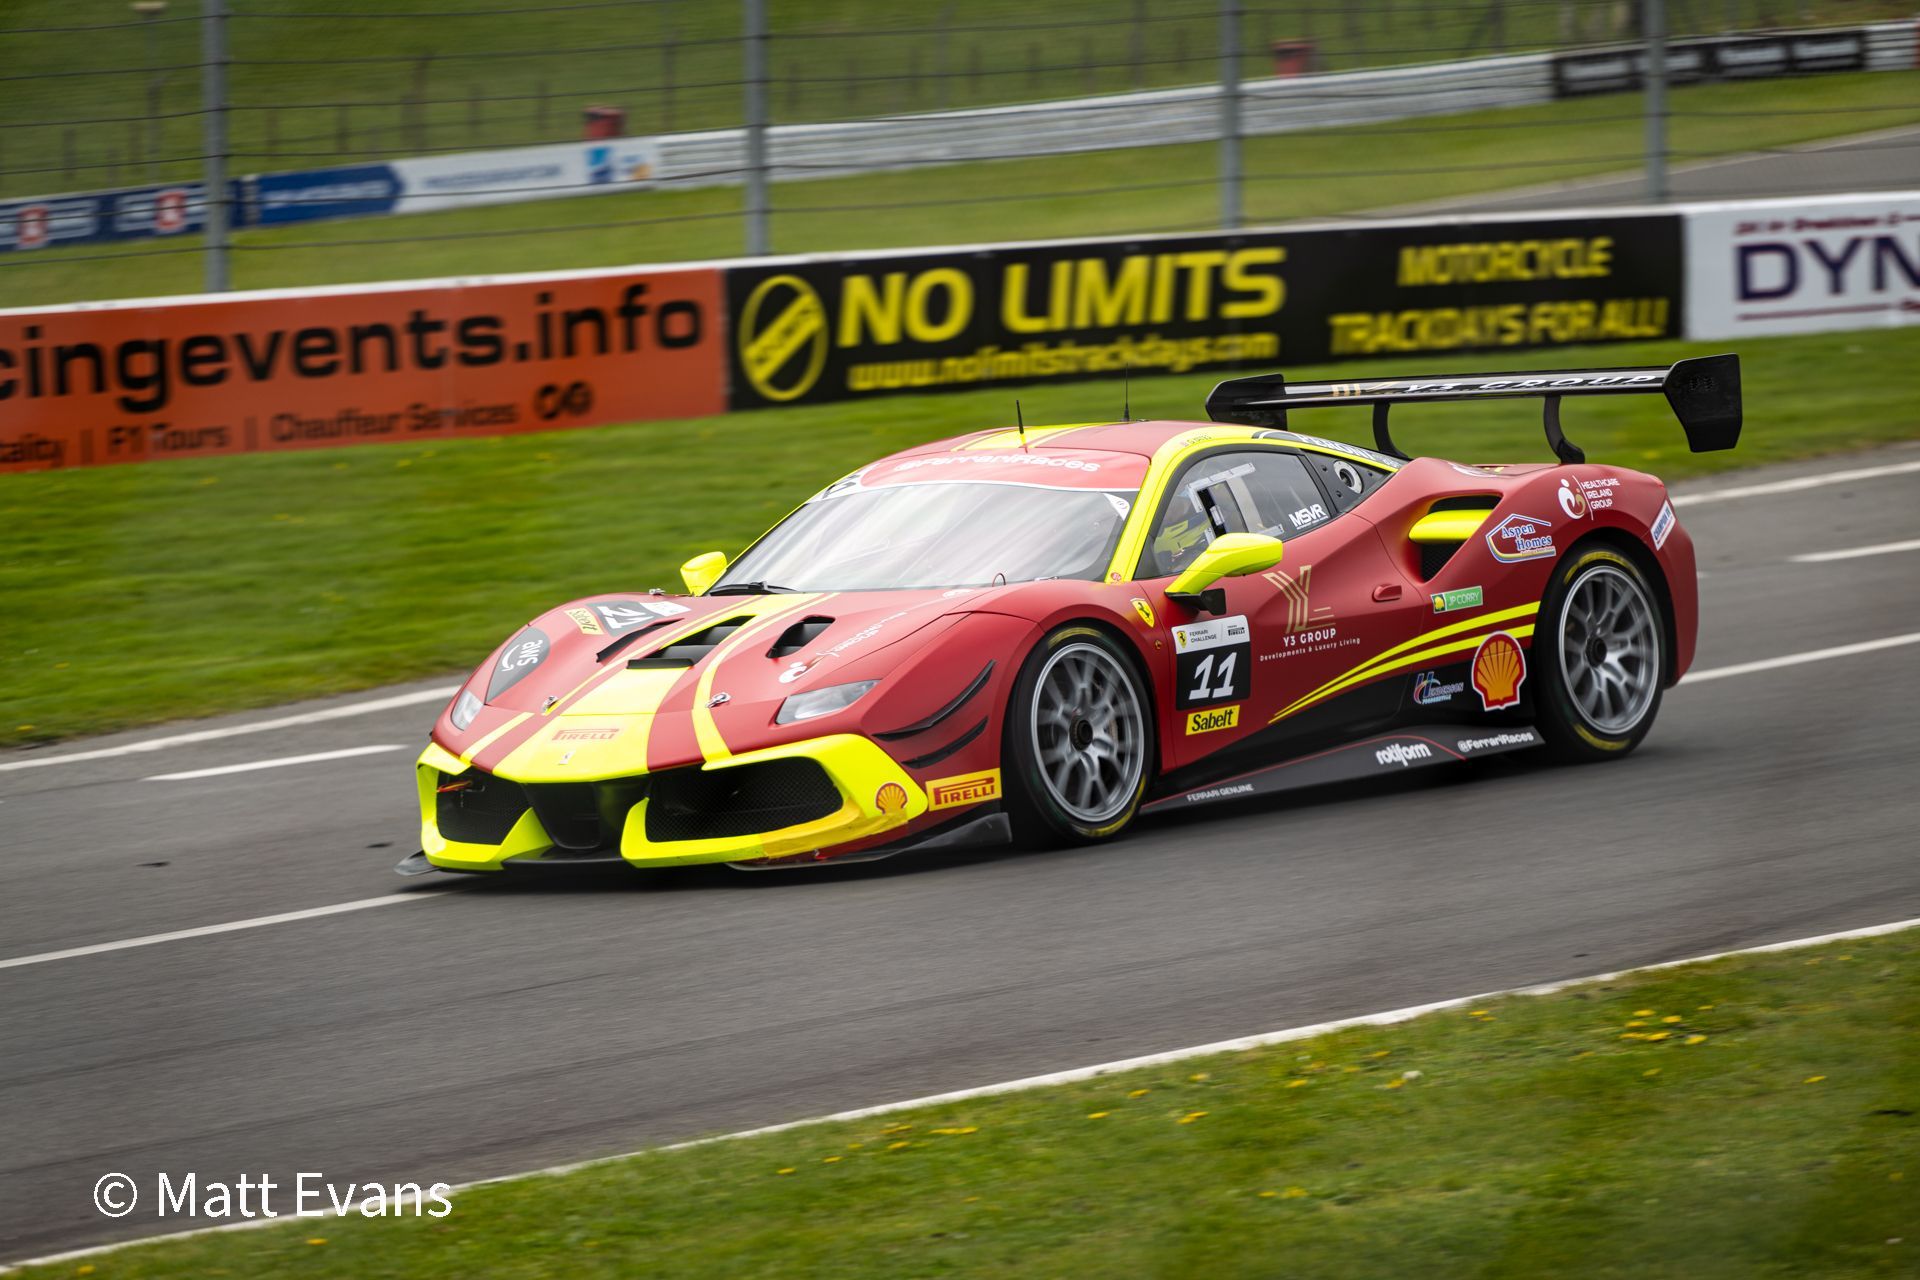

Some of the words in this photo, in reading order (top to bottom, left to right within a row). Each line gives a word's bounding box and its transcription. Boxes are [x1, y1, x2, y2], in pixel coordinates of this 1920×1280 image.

[1397, 237, 1614, 286] MOTORCYCLE
[837, 267, 975, 348] NO
[1002, 247, 1287, 333] LIMITS
[1329, 303, 1527, 355] TRACKDAYS
[1529, 299, 1598, 343] FOR
[1600, 297, 1670, 339] ALL!
[1480, 375, 1656, 389] GROUP
[1581, 478, 1620, 489] HEALTHCARE
[1586, 488, 1613, 499] IRELAND
[1590, 498, 1613, 510] GROUP
[1288, 504, 1326, 527] MSVR
[1502, 524, 1535, 538] Aspen
[1516, 535, 1552, 551] Homes
[1189, 629, 1208, 637] FERRARI
[1190, 634, 1217, 643] CHALLENGE
[1283, 635, 1296, 647] Y3
[1300, 627, 1337, 644] GROUP
[517, 639, 544, 667] aws
[1259, 647, 1306, 662] Developments
[1314, 641, 1337, 651] Luxury
[1339, 637, 1361, 647] Living
[1188, 652, 1237, 700] 11
[1192, 709, 1234, 732] Sabelt
[552, 728, 619, 741] PIRELLI
[1457, 731, 1534, 752] @FerrariRaces
[1375, 742, 1432, 767] rotiform
[933, 776, 996, 806] PIRELLI
[1186, 789, 1220, 802] FERRARI
[1219, 783, 1254, 796] GENUINE
